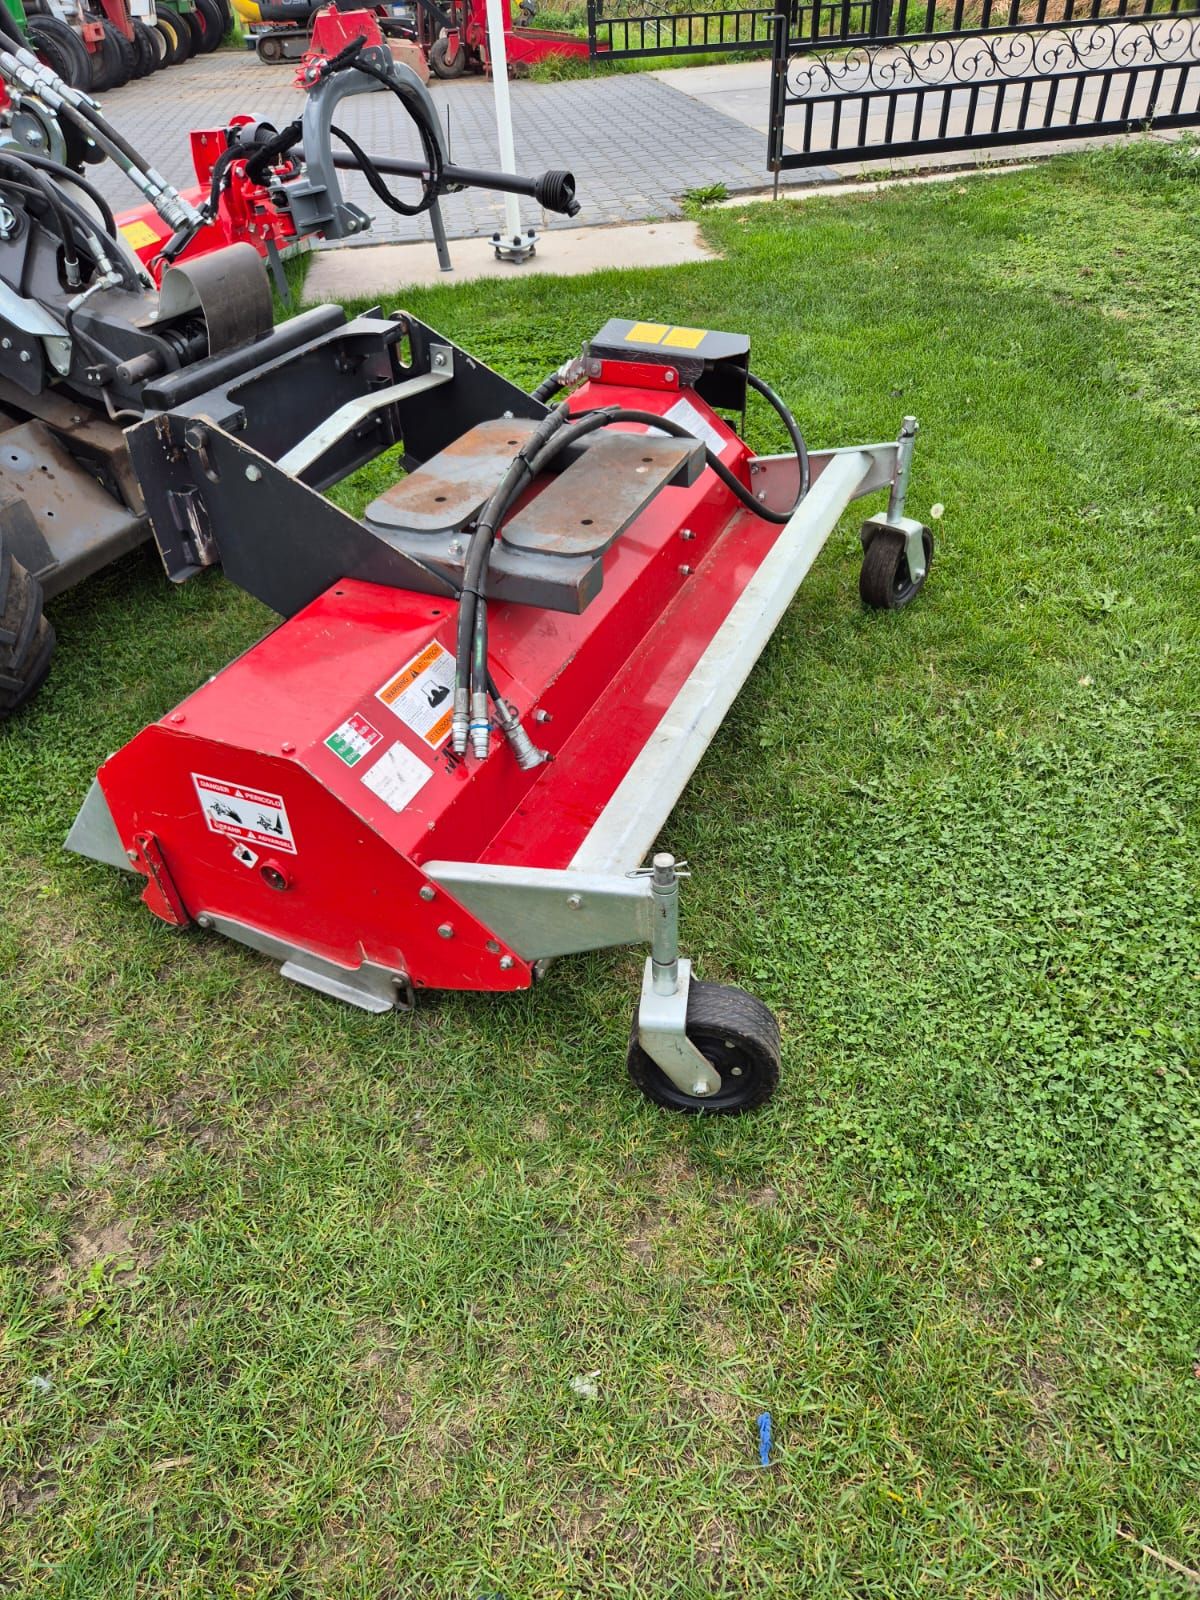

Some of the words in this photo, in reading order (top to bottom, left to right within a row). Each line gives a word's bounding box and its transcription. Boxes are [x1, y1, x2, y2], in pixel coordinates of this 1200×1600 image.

[385, 676, 409, 698] WARNING
[200, 780, 230, 793] DANGER
[244, 792, 281, 807] PERICOLO
